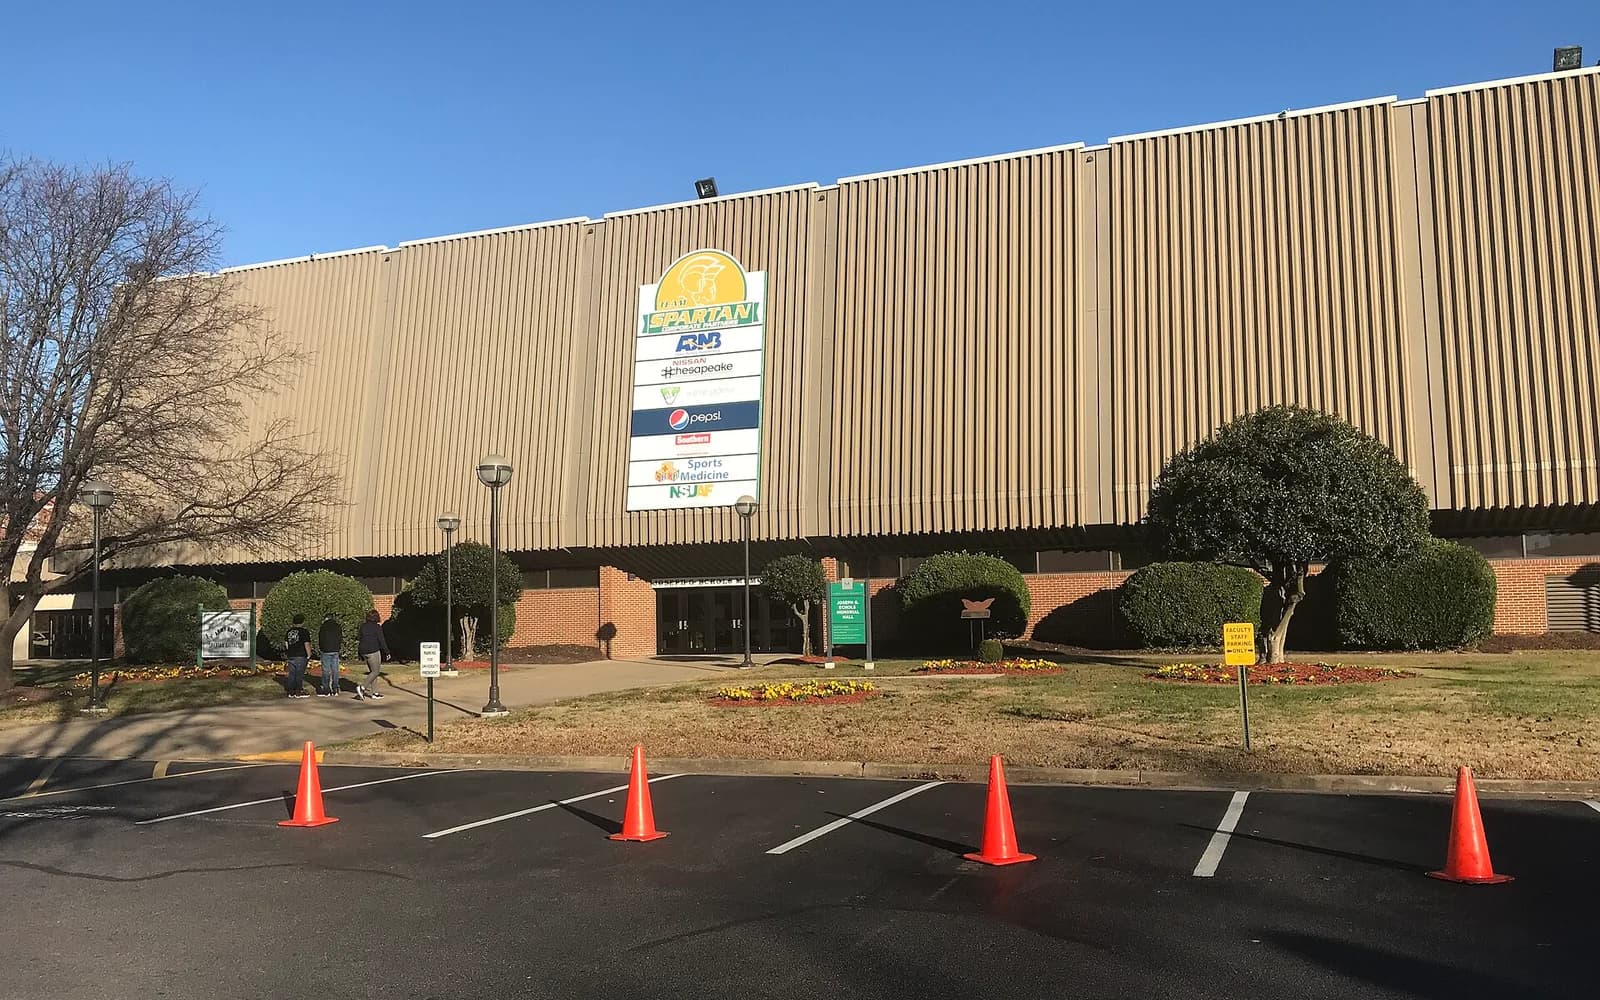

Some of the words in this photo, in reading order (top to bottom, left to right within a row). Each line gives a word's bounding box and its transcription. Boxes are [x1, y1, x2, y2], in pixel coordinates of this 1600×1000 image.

[650, 303, 752, 328] SPARTAN
[672, 357, 707, 367] NISSAN
[688, 459, 722, 470] Sports
[680, 471, 729, 481] Medicine
